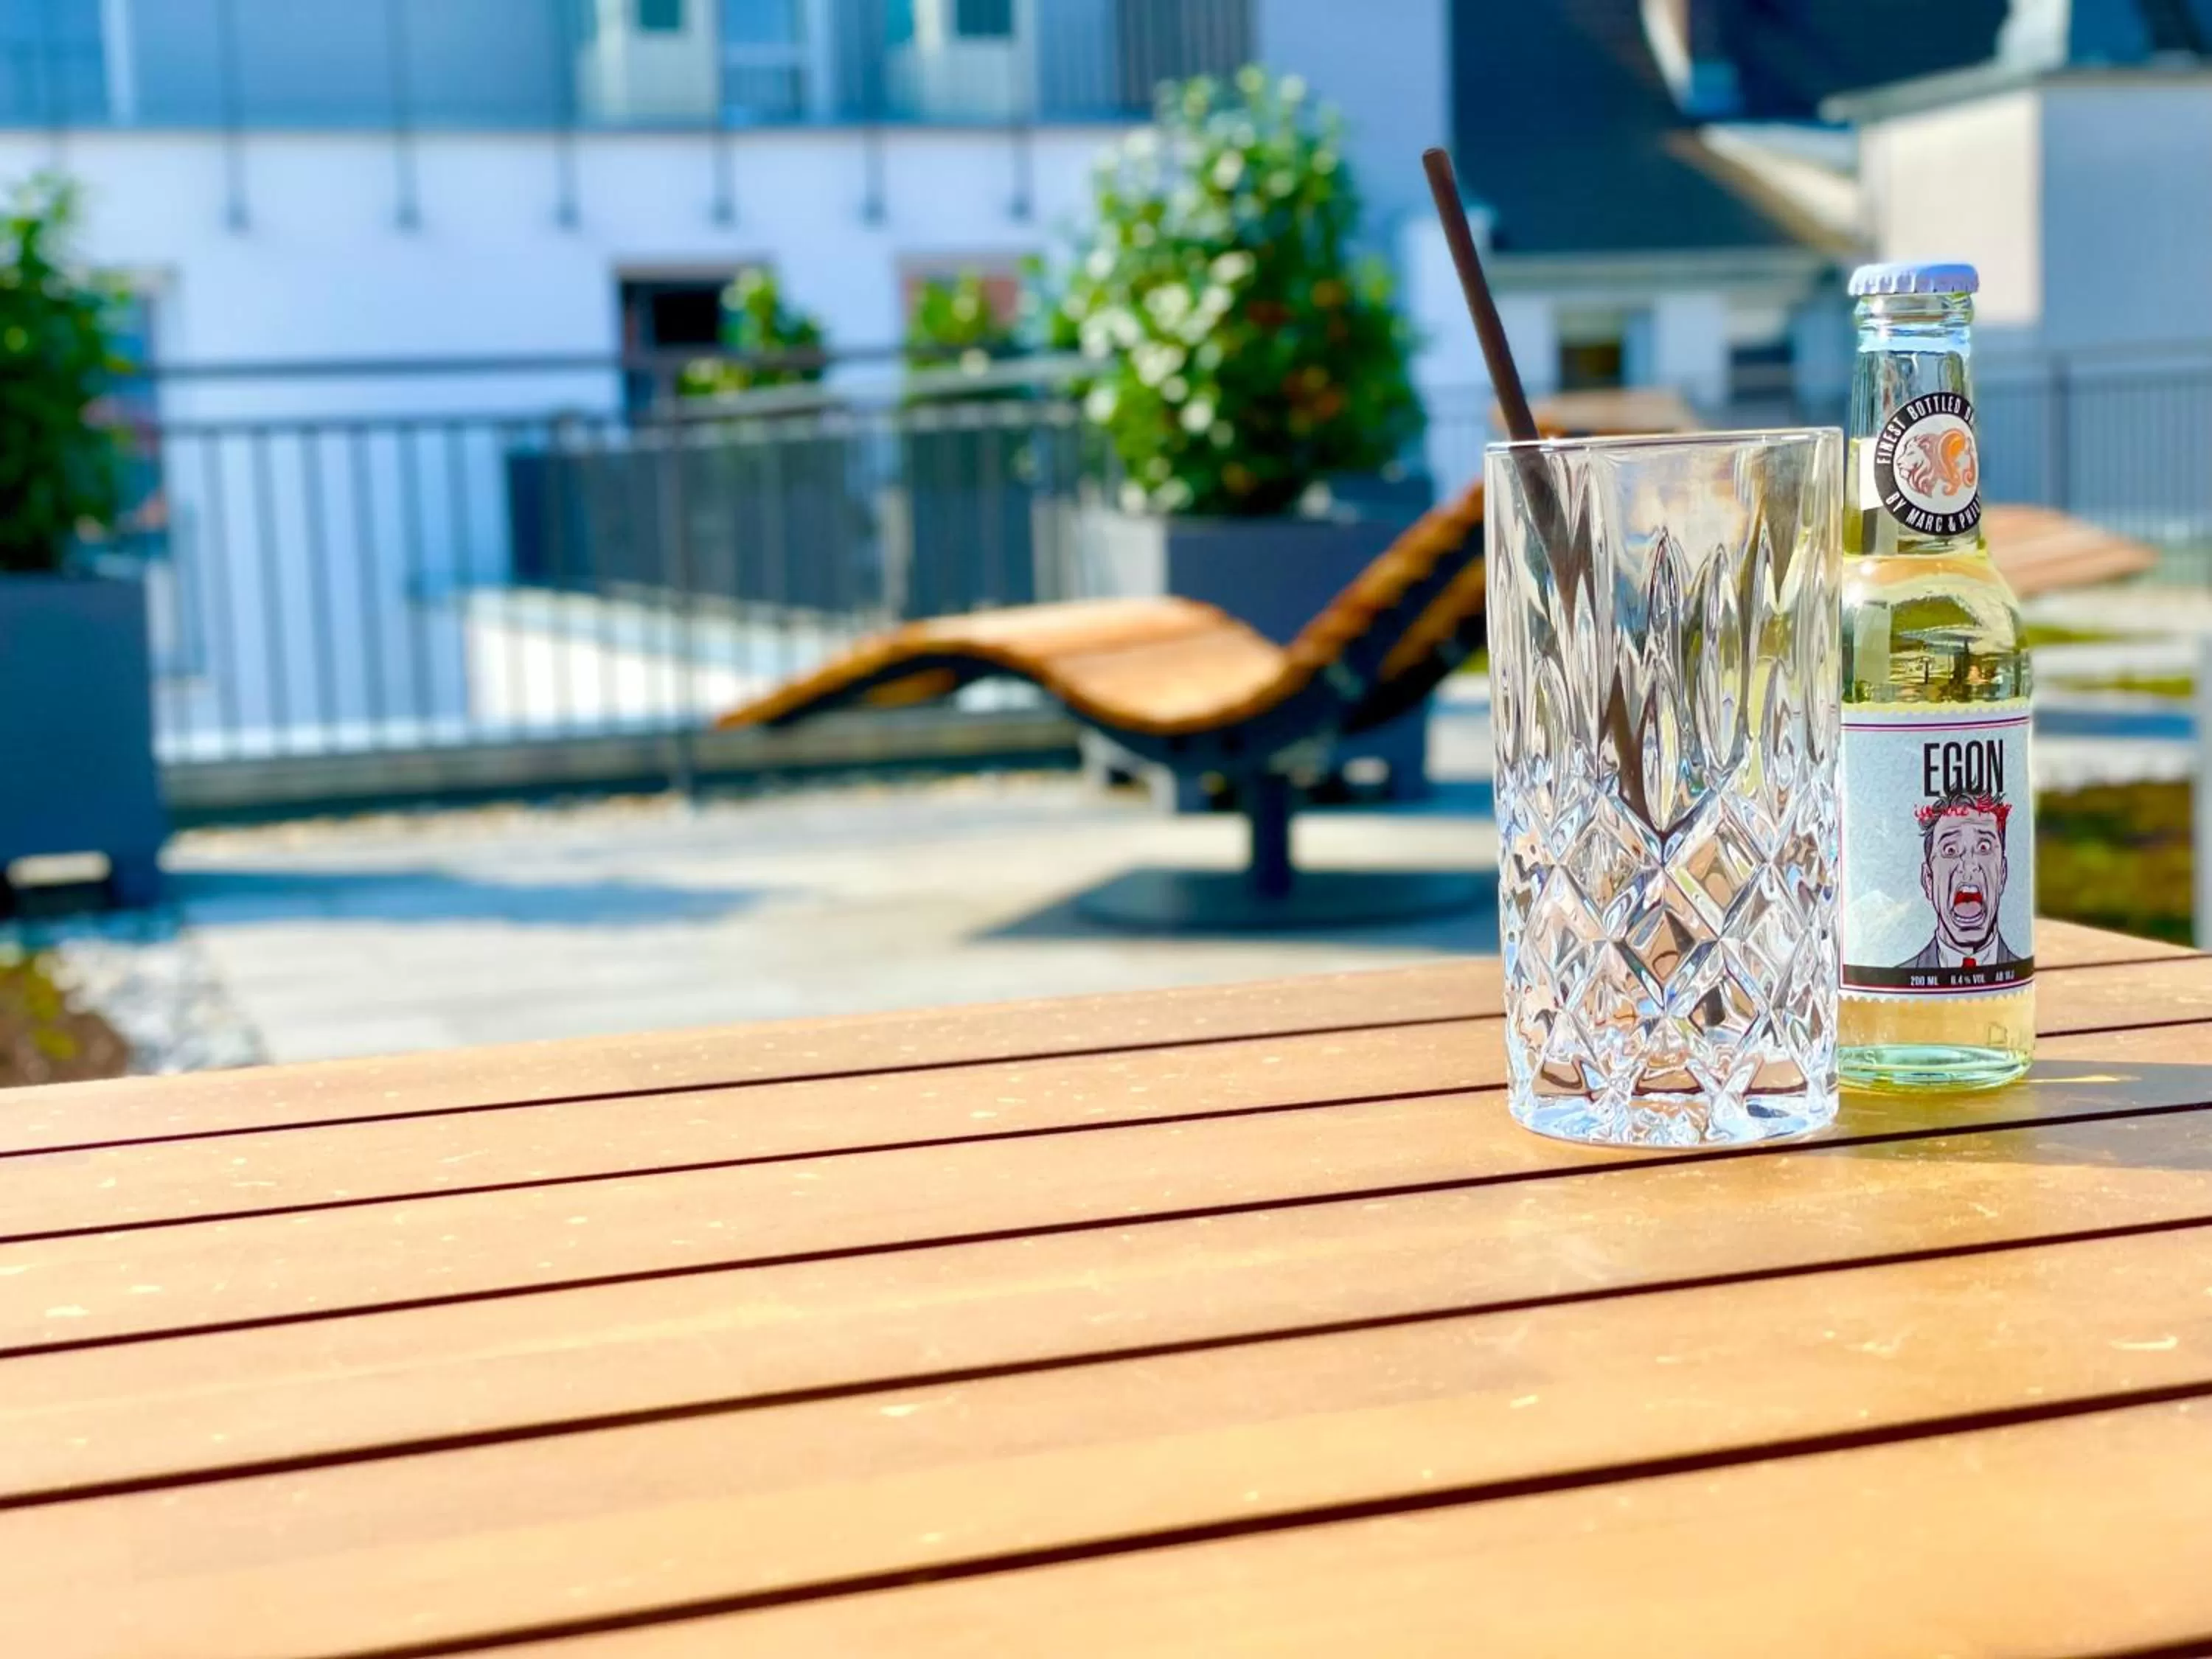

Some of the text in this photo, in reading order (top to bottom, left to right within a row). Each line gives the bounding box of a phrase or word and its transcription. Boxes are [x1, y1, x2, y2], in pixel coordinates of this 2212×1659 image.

[1877, 417, 1906, 465] FINEST
[1906, 394, 1961, 420] BOTTLED
[1885, 491, 1907, 512] BY
[1906, 508, 1942, 532] MARC
[1924, 739, 2003, 797] EGON
[1927, 975, 1938, 986] ML
